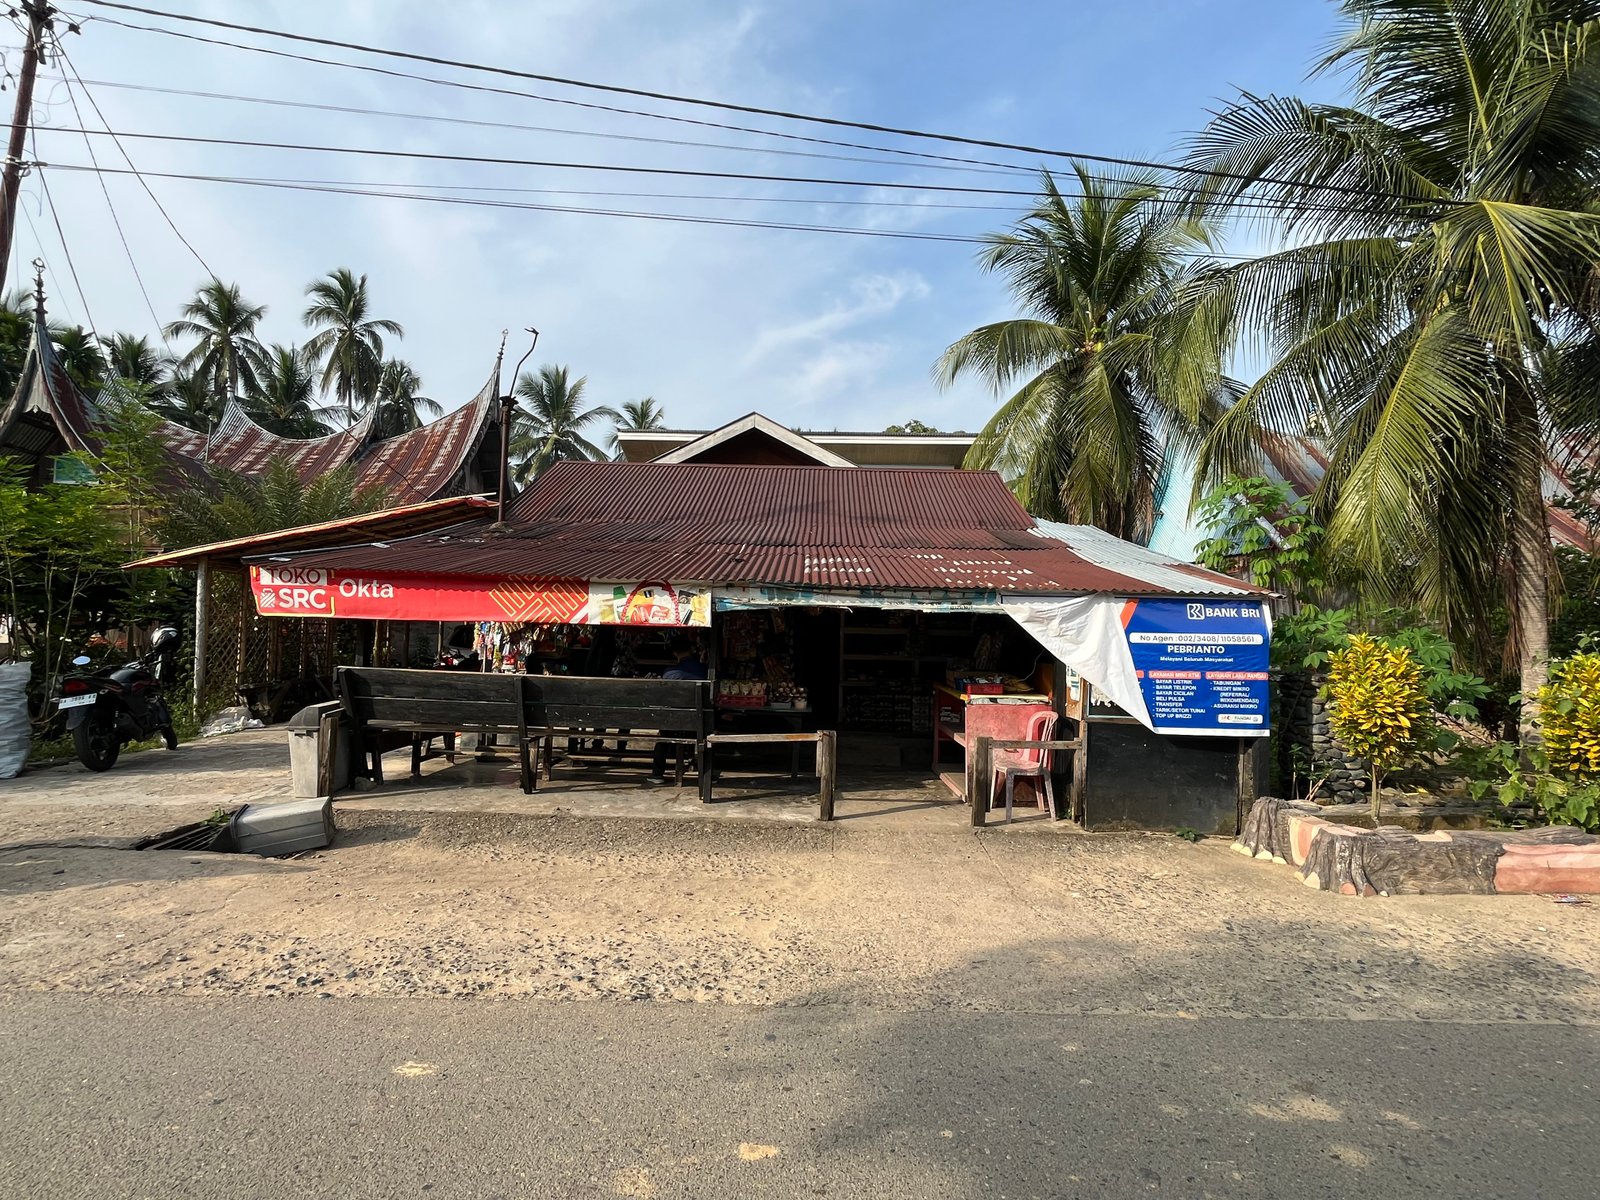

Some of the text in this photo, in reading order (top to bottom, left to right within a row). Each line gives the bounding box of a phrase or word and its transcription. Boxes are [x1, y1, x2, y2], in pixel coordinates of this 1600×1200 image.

[266, 567, 320, 584] TOKO
[339, 578, 394, 598] Okta
[278, 588, 327, 609] SRC
[1206, 608, 1260, 618] BANK BRI
[1152, 635, 1173, 643] Agen
[1167, 645, 1225, 654] PEBRIANTO
